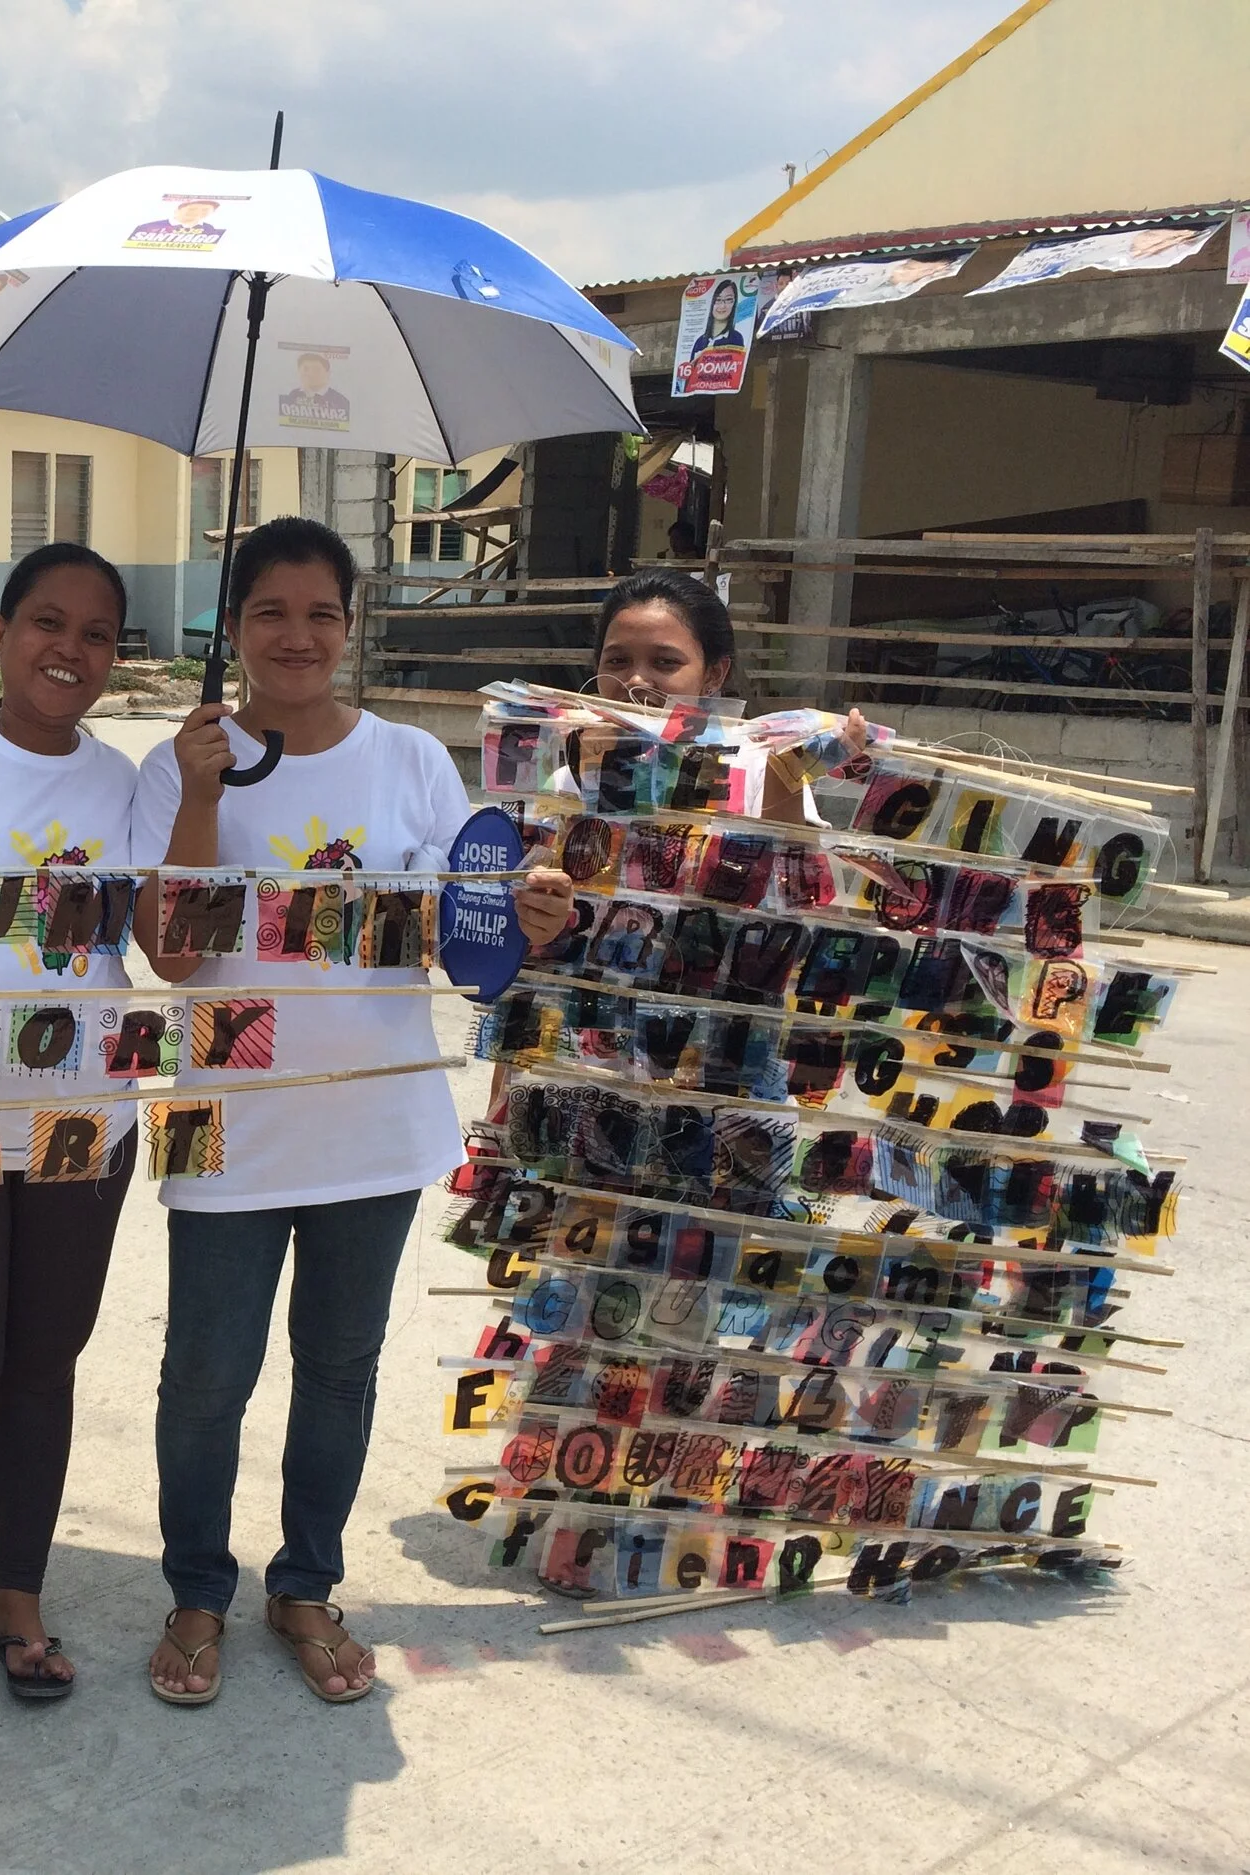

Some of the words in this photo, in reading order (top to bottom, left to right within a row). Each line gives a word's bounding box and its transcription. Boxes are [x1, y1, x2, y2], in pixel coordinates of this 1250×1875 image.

[130, 231, 220, 244] SANTIAGO
[679, 365, 692, 377] 16
[459, 842, 508, 866] JOSIE
[456, 907, 507, 935] PHILLIP
[453, 928, 505, 948] SALVADOR
